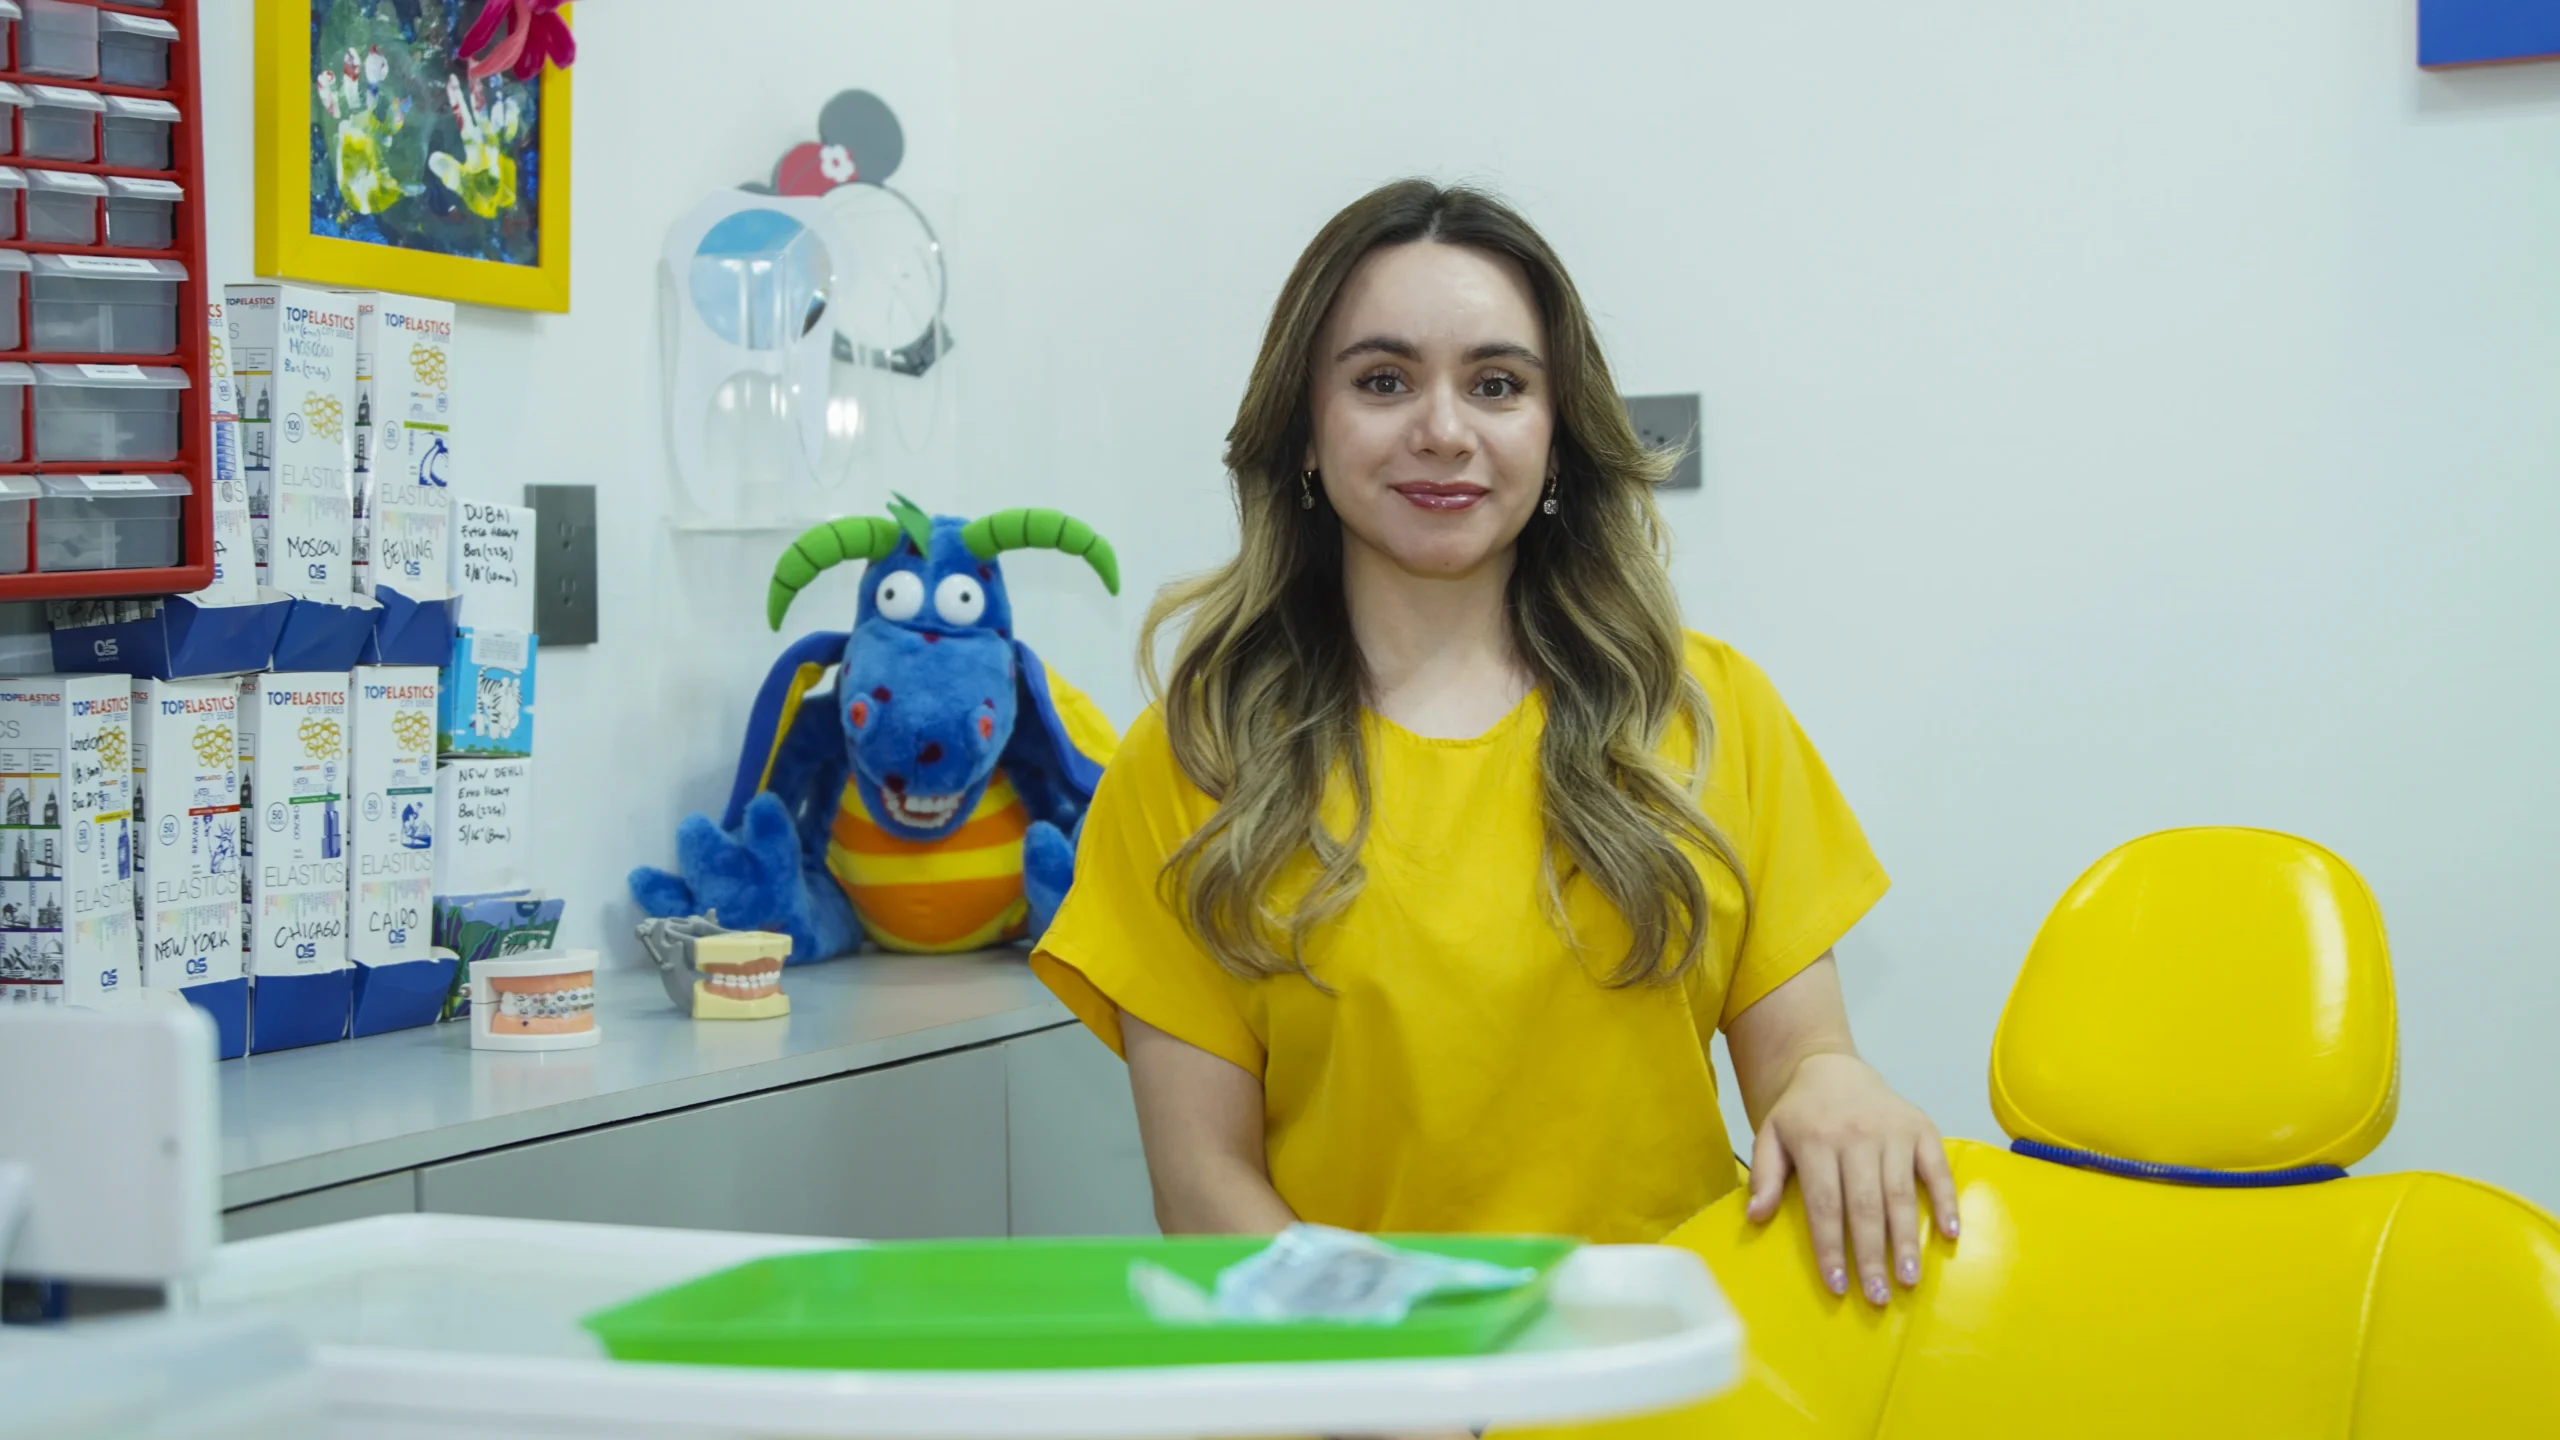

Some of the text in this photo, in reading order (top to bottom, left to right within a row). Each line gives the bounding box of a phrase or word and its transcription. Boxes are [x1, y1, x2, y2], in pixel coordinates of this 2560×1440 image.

[226, 298, 275, 306] TOPELASTICS
[286, 307, 355, 331] TOPELASTICS
[384, 313, 451, 336] TOPELASTICS
[321, 326, 334, 337] CITY
[287, 420, 300, 431] 100
[281, 464, 347, 490] ELASTIC
[381, 483, 448, 508] ELASTICS
[463, 503, 509, 524] DUBAI
[287, 535, 342, 558] MOSCOW
[0, 693, 61, 702] TOPELASTICS
[267, 691, 345, 706] TOPELASTICS
[364, 685, 435, 699] TOPELASTICS
[72, 696, 129, 717] TOPELASTICS
[161, 695, 235, 715] TOPELASTICS
[307, 706, 344, 715] CITY SERIES
[200, 711, 235, 722] CITY SERIES
[459, 767, 488, 782] NEW
[272, 810, 282, 821] 50
[163, 822, 174, 834] 50
[362, 851, 432, 875] ELASTICS
[265, 861, 344, 887] ELASTICS
[157, 873, 239, 903] ELASTICS
[369, 908, 419, 932] CAIRO
[274, 919, 341, 949] CHICAGO
[154, 931, 230, 962] NEW YORK
